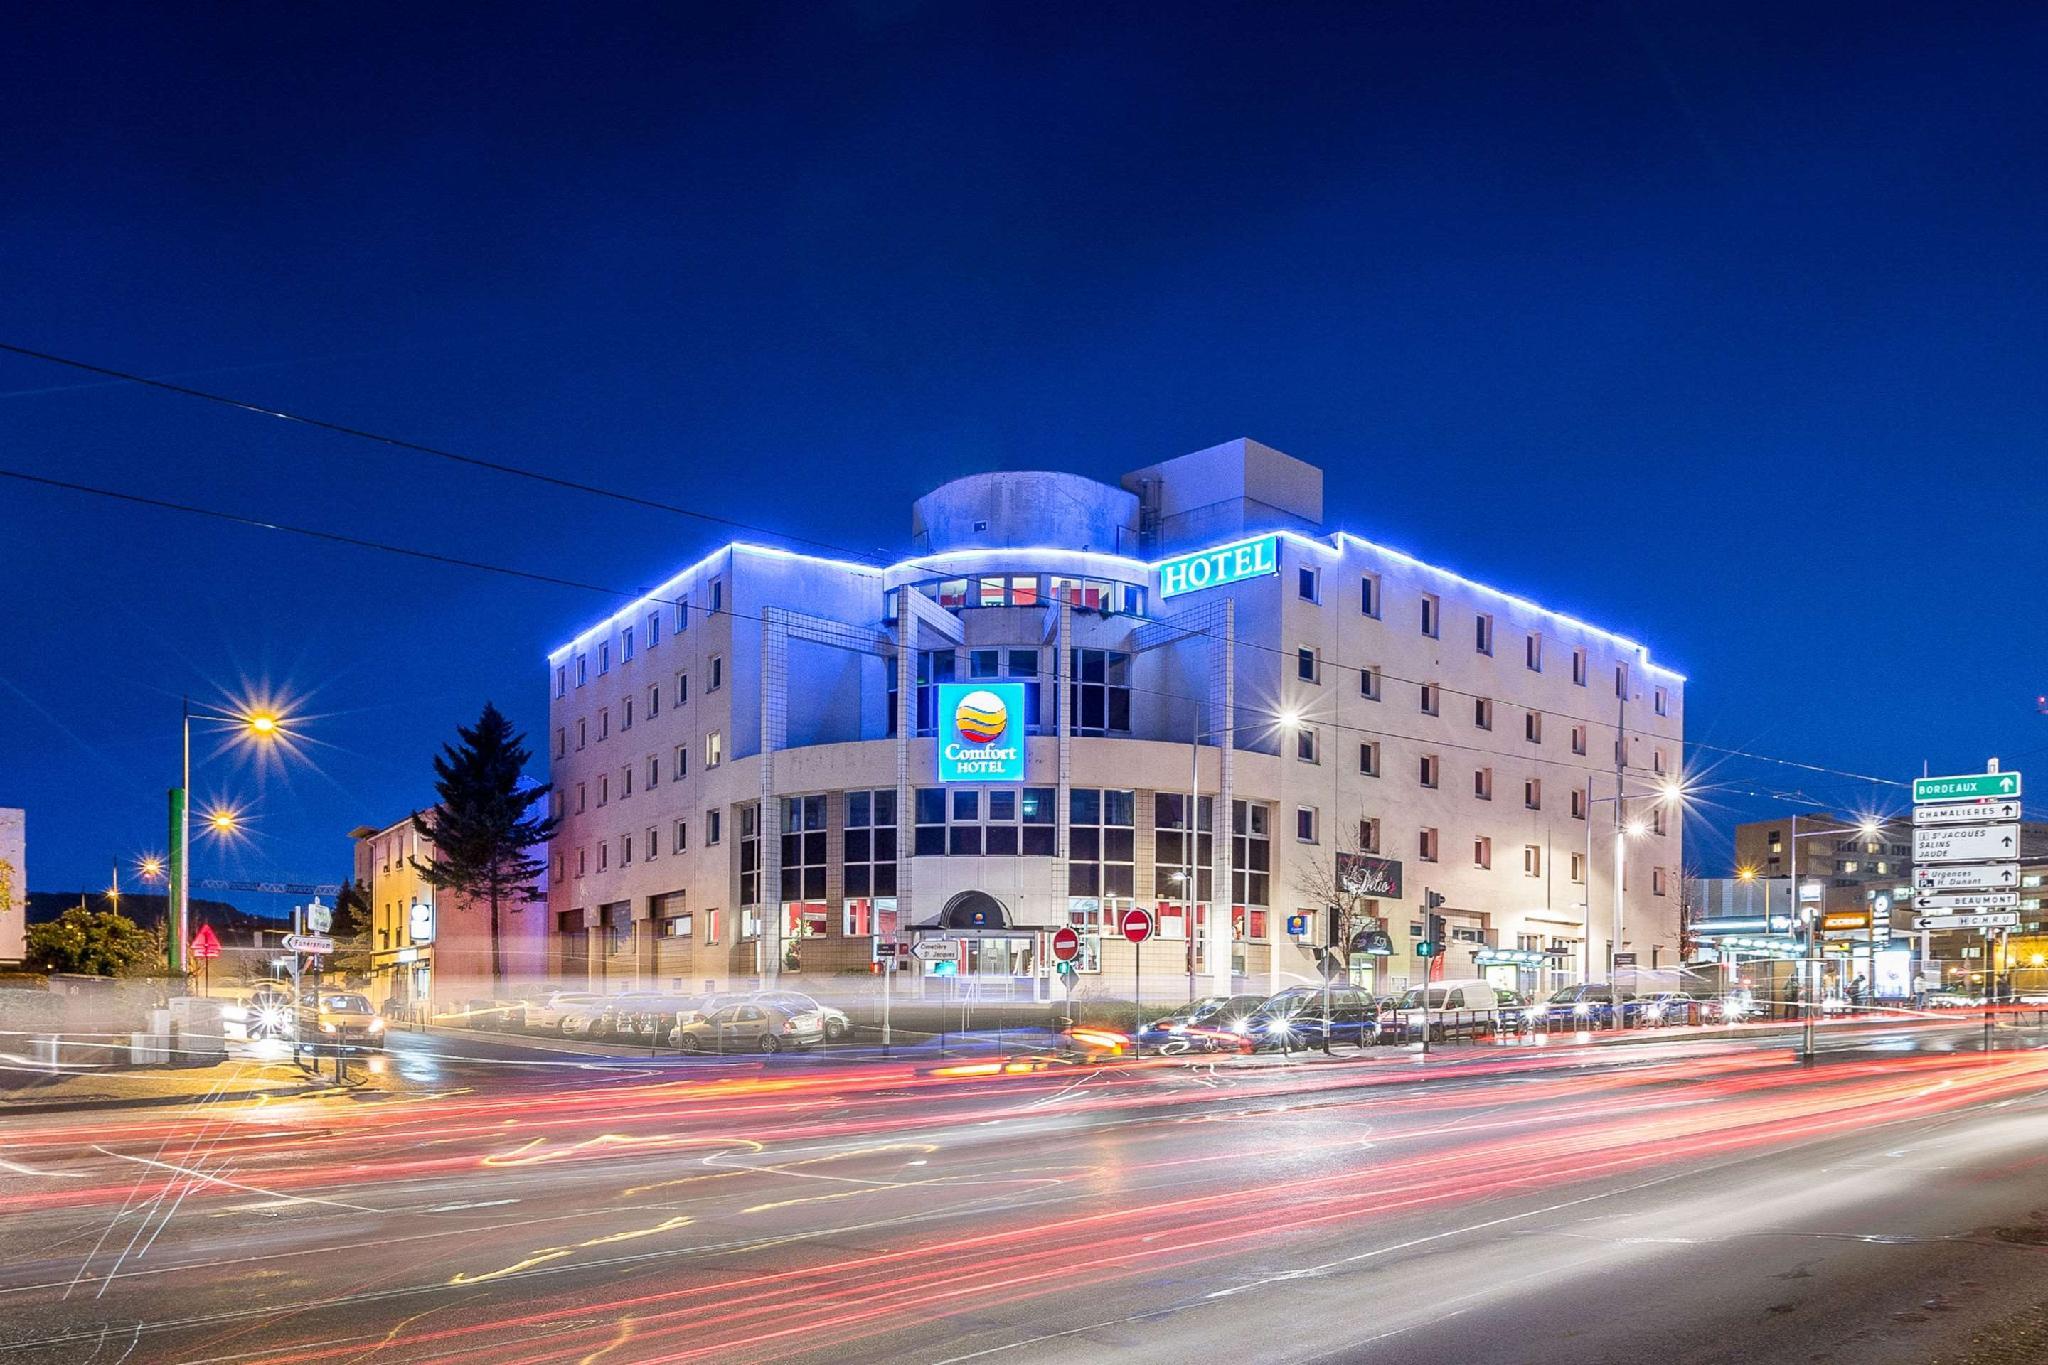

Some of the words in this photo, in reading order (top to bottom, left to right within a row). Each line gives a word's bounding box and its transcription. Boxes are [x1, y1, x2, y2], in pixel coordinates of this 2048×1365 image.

[1165, 543, 1272, 593] HOTEL
[945, 743, 1017, 760] Comfort
[957, 761, 1006, 774] HOTEL
[1918, 783, 1977, 795] BORDEAUX
[1942, 829, 1986, 839] JACQUES
[1919, 841, 1950, 849] SALINS
[1919, 850, 1948, 858] JAUDE
[1931, 871, 1972, 879] Urgences
[1955, 895, 2012, 905] BEAUMONT
